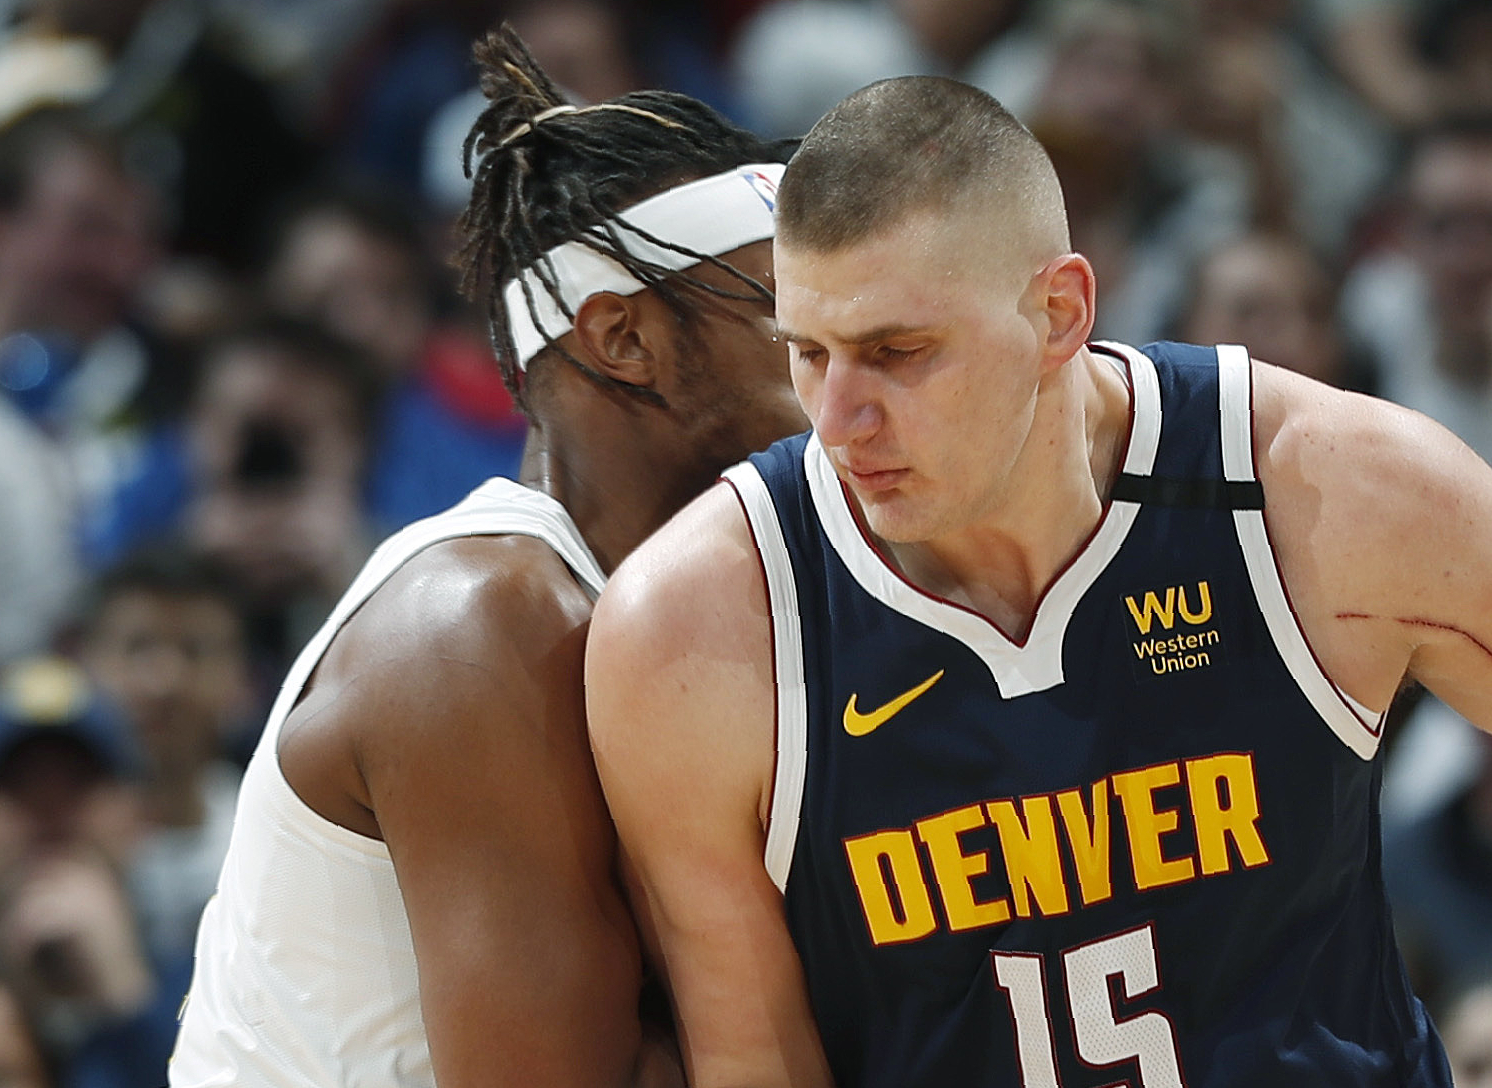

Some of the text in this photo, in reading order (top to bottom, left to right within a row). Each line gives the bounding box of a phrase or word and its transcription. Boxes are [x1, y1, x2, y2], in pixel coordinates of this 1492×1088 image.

[1125, 581, 1212, 635] WU
[1133, 630, 1219, 659] Western
[1151, 652, 1210, 674] Union
[843, 752, 1270, 945] DENVER
